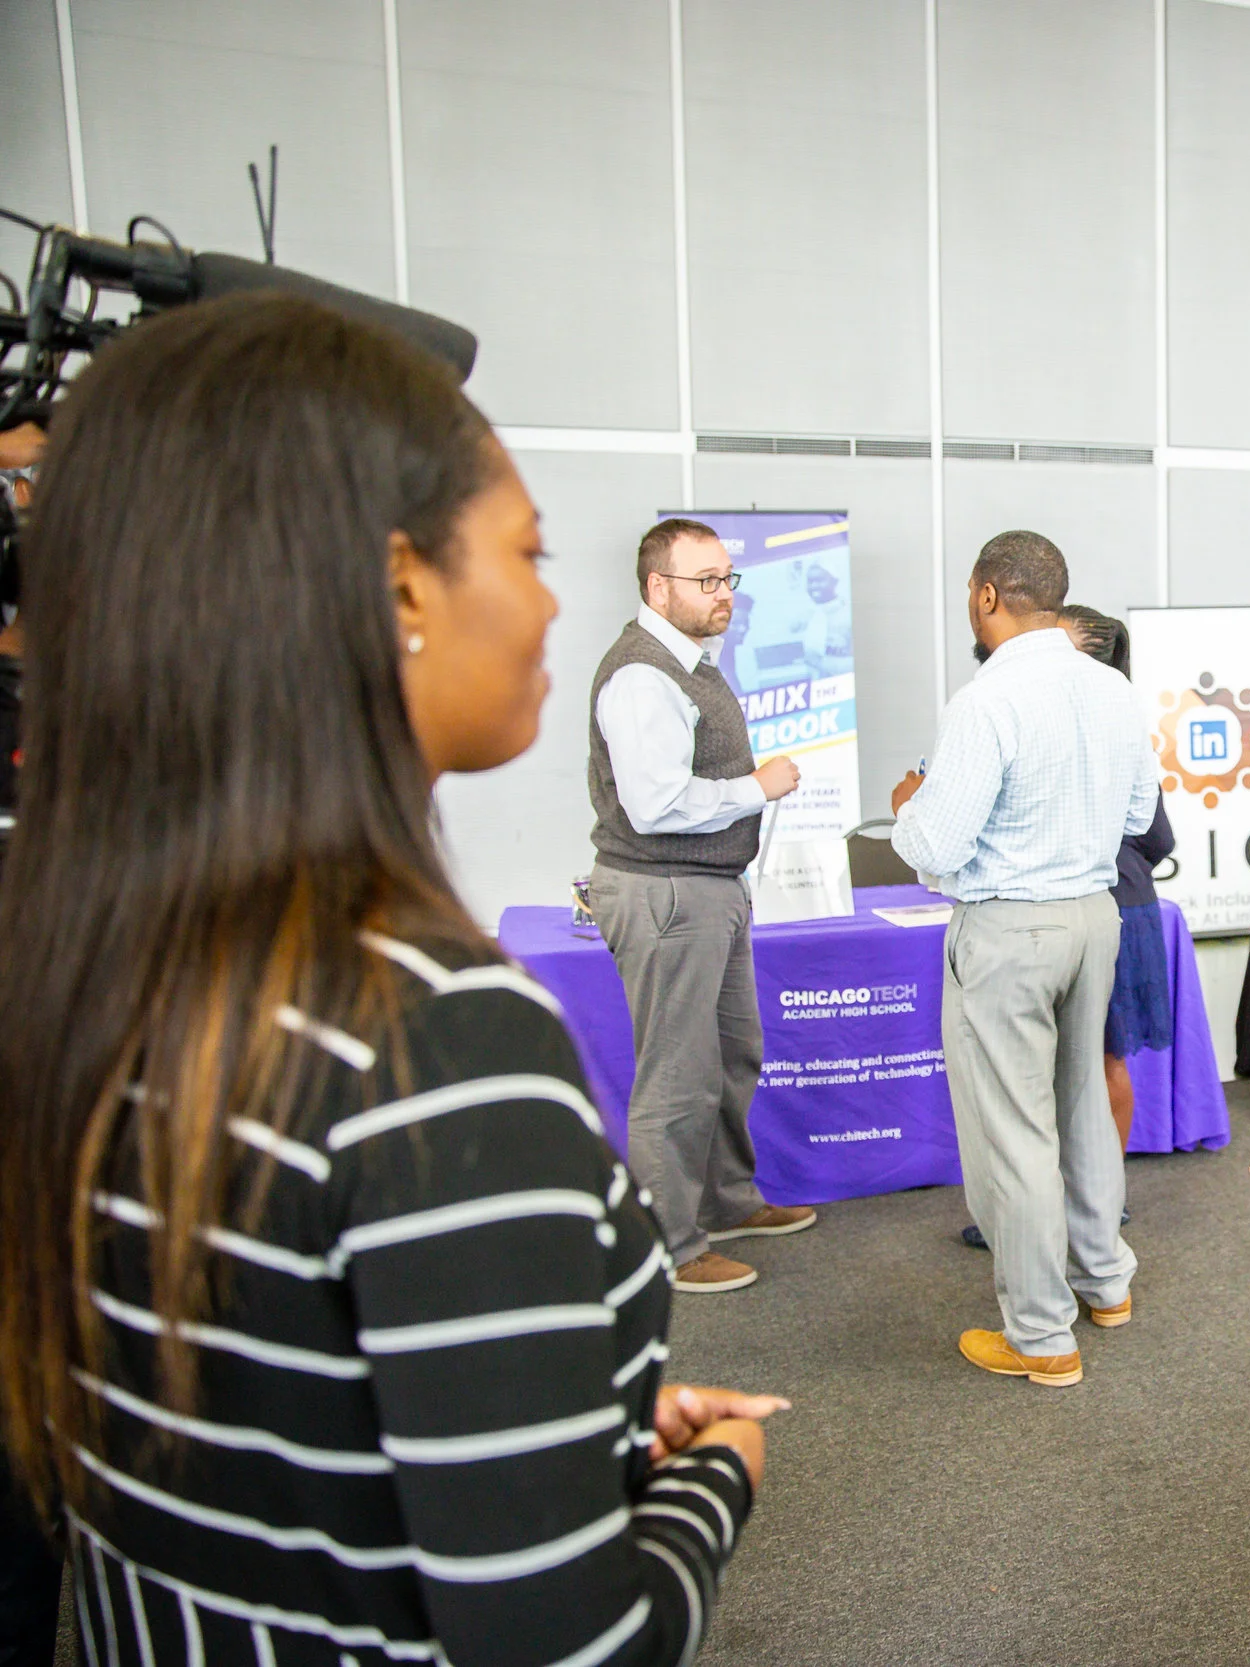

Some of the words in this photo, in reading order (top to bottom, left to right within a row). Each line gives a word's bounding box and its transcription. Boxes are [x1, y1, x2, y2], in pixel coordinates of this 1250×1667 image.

[1191, 723, 1226, 759] in
[782, 1007, 838, 1020] ACADEMY
[840, 1006, 868, 1018] HIGH
[869, 1001, 916, 1015] SCHOOL
[805, 1057, 860, 1071] educating
[861, 1054, 883, 1067] and
[884, 1048, 944, 1065] connecting
[769, 1077, 794, 1087] new
[795, 1073, 857, 1089] generation
[858, 1069, 870, 1083] of
[873, 1064, 934, 1081] technology
[809, 1127, 902, 1144] www.chitech.org
